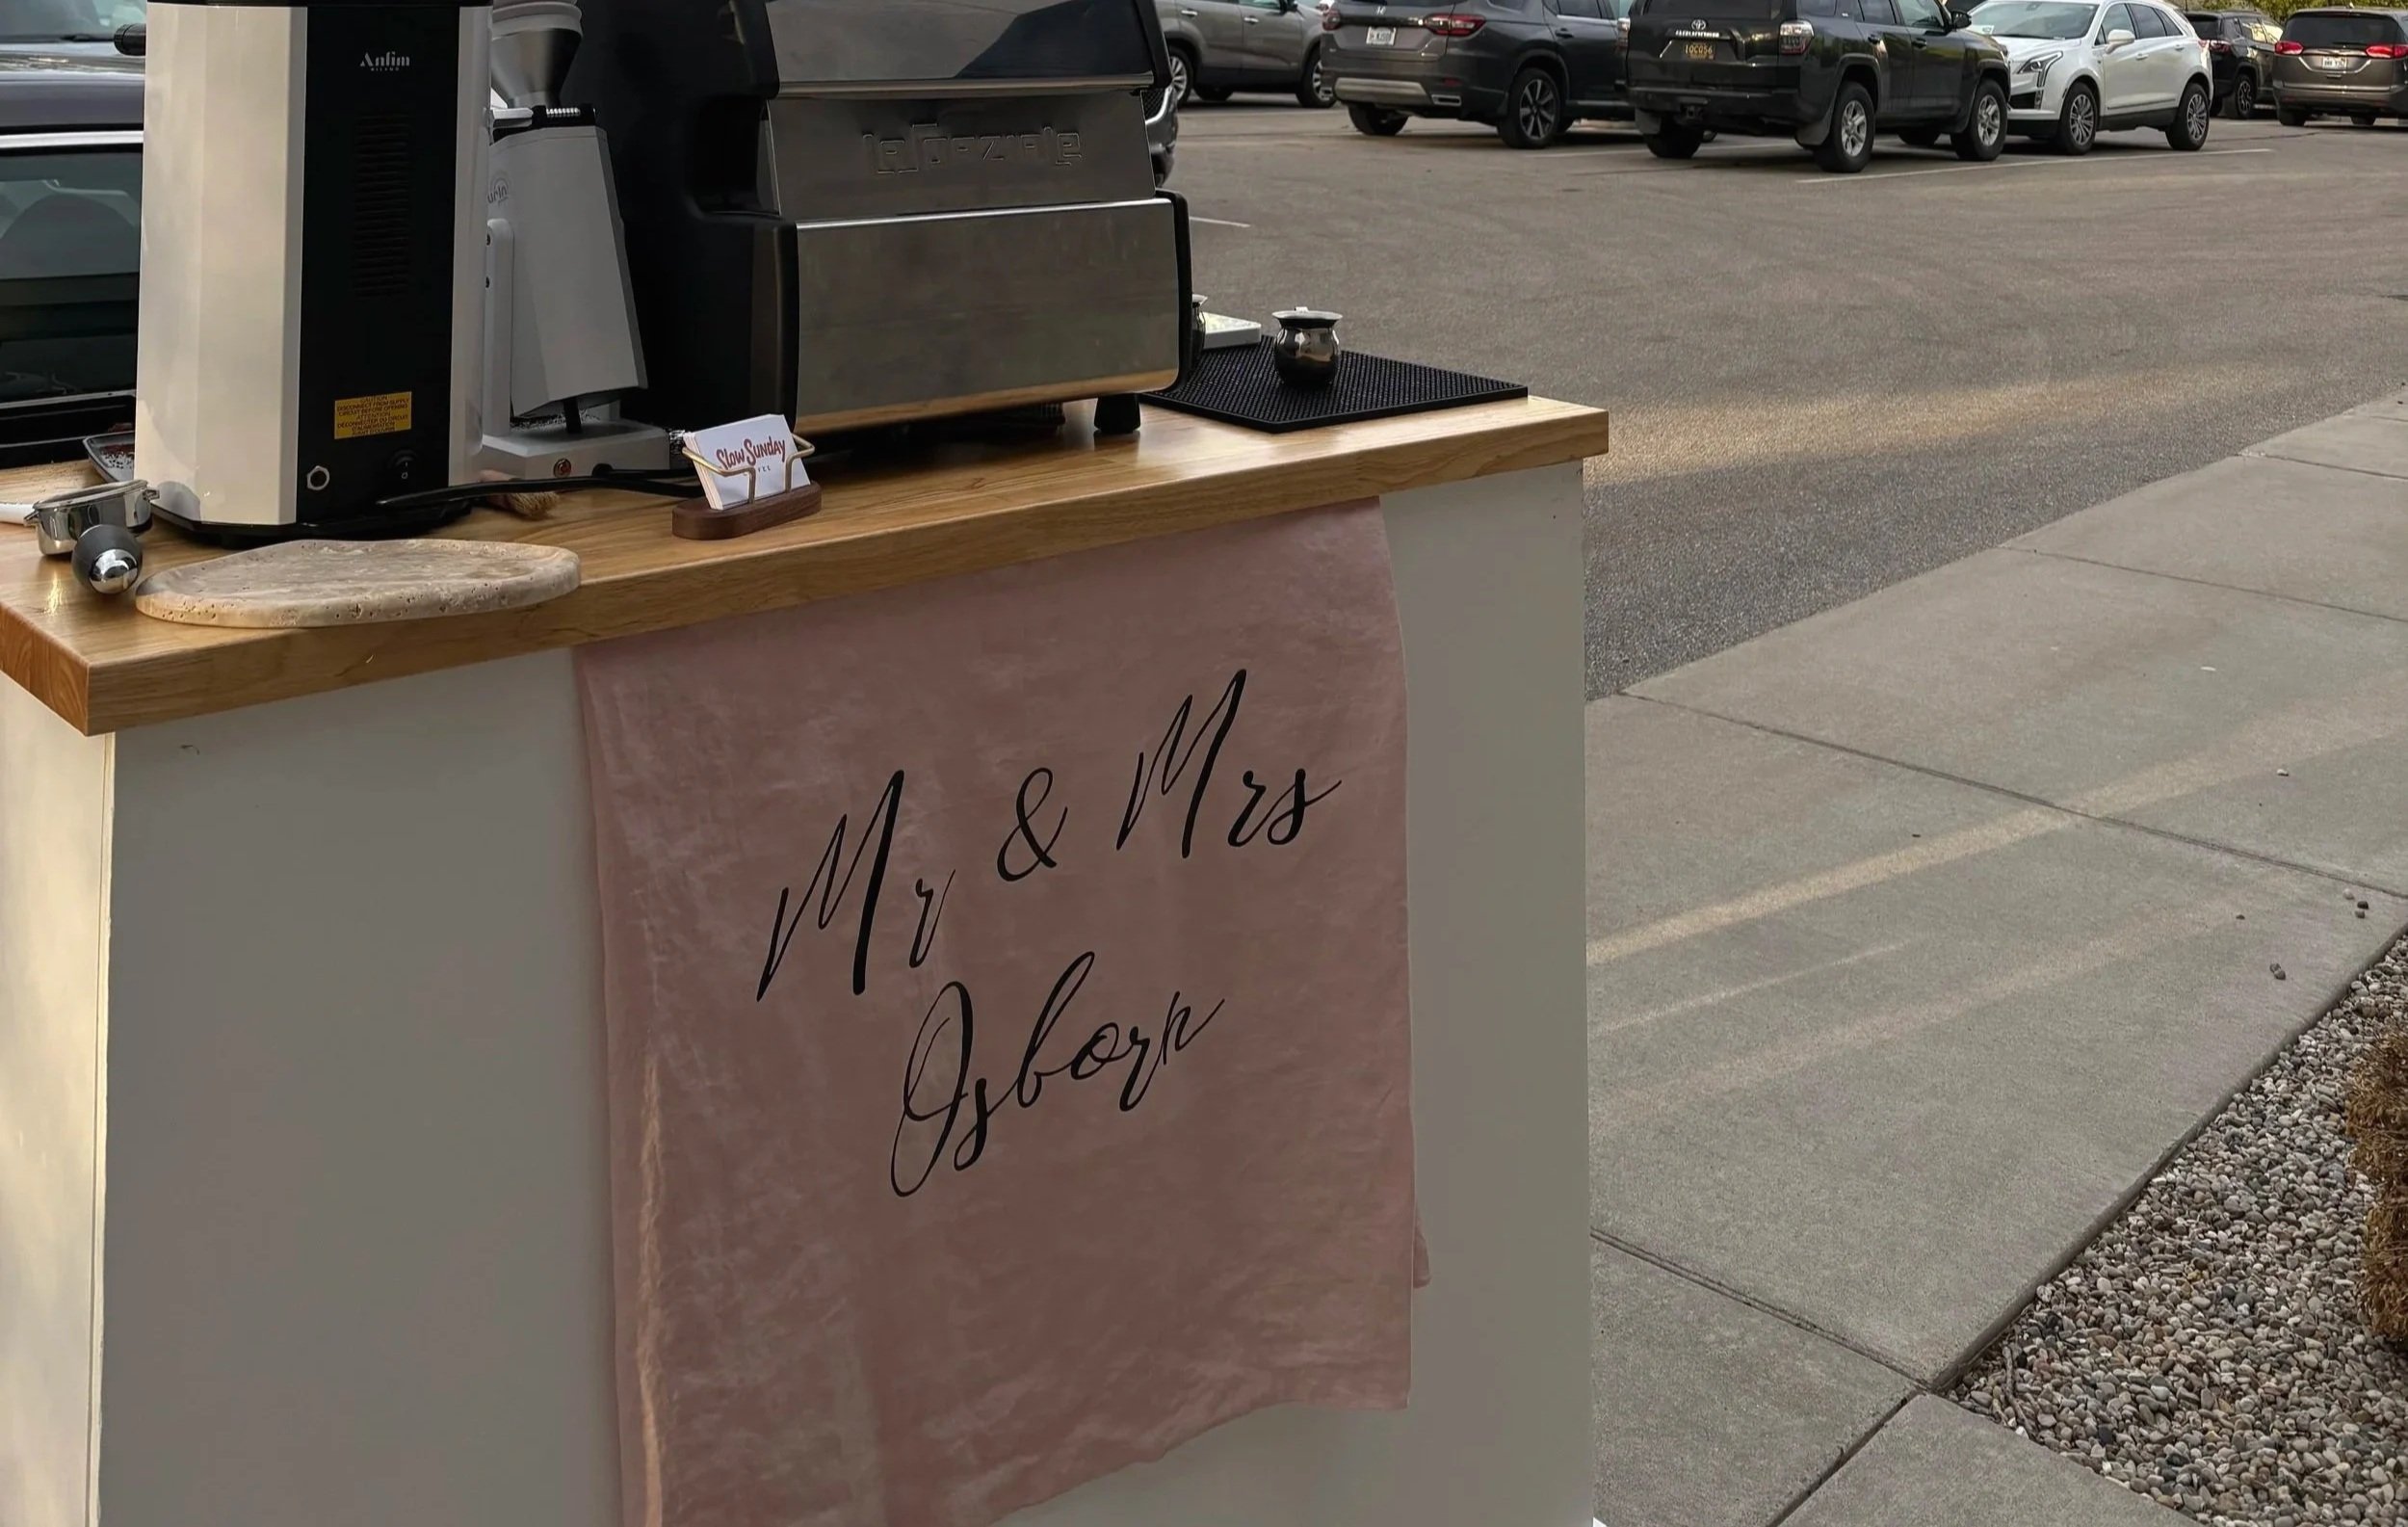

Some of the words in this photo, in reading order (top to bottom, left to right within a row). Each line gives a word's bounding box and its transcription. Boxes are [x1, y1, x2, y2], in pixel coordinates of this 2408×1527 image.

[359, 51, 410, 66] Anfim
[717, 448, 745, 470] Slow
[756, 770, 955, 1002] Mr
[996, 767, 1068, 882] &
[1116, 669, 1342, 858] Mrs
[891, 951, 1224, 1198] Osborn
